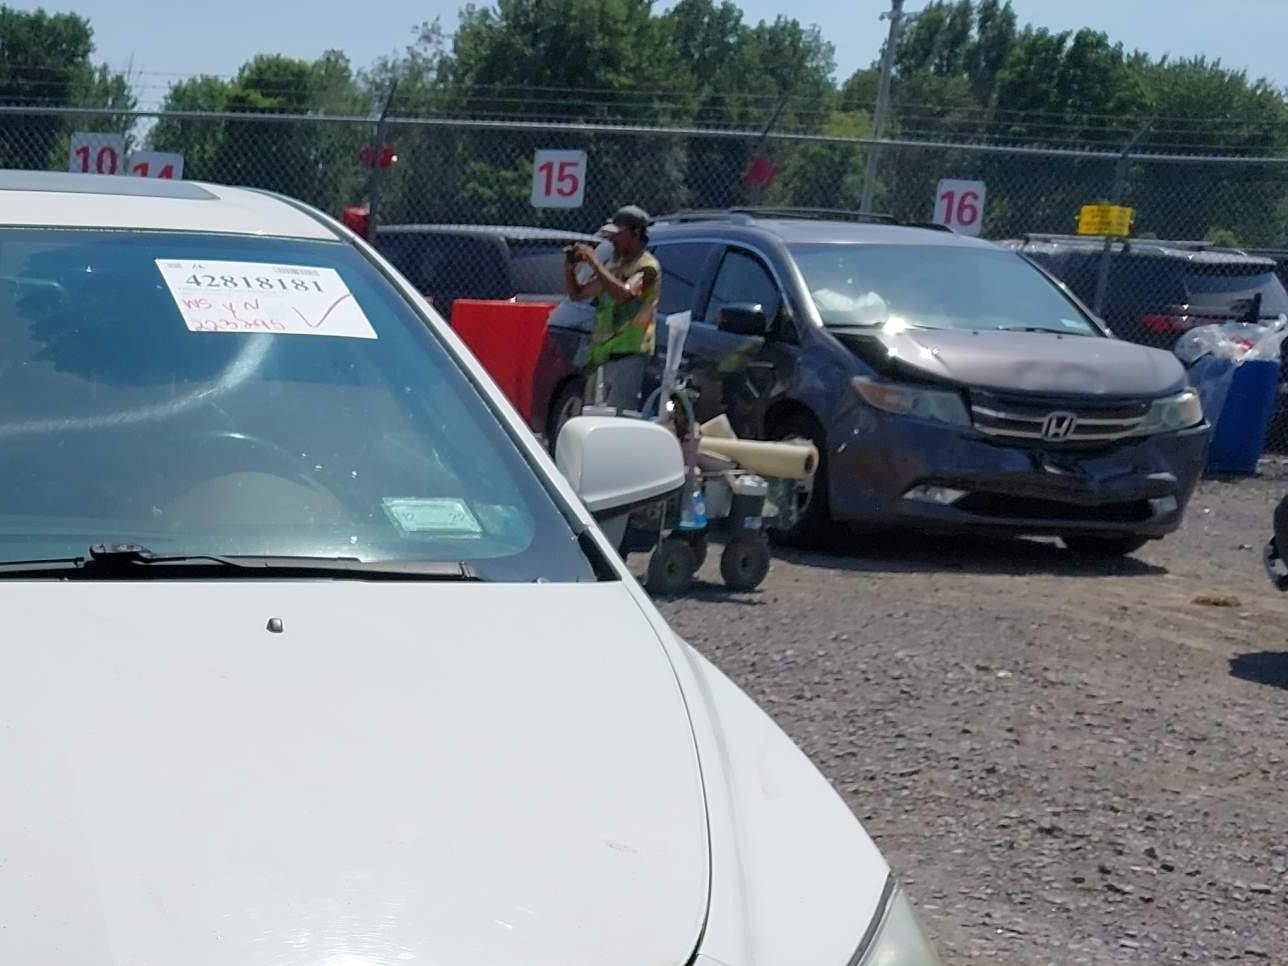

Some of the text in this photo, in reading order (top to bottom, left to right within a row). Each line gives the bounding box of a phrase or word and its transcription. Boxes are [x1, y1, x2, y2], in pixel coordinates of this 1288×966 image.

[75, 144, 117, 175] 10
[538, 161, 580, 197] 15
[940, 191, 979, 227] 16
[185, 274, 324, 293] 42818181
